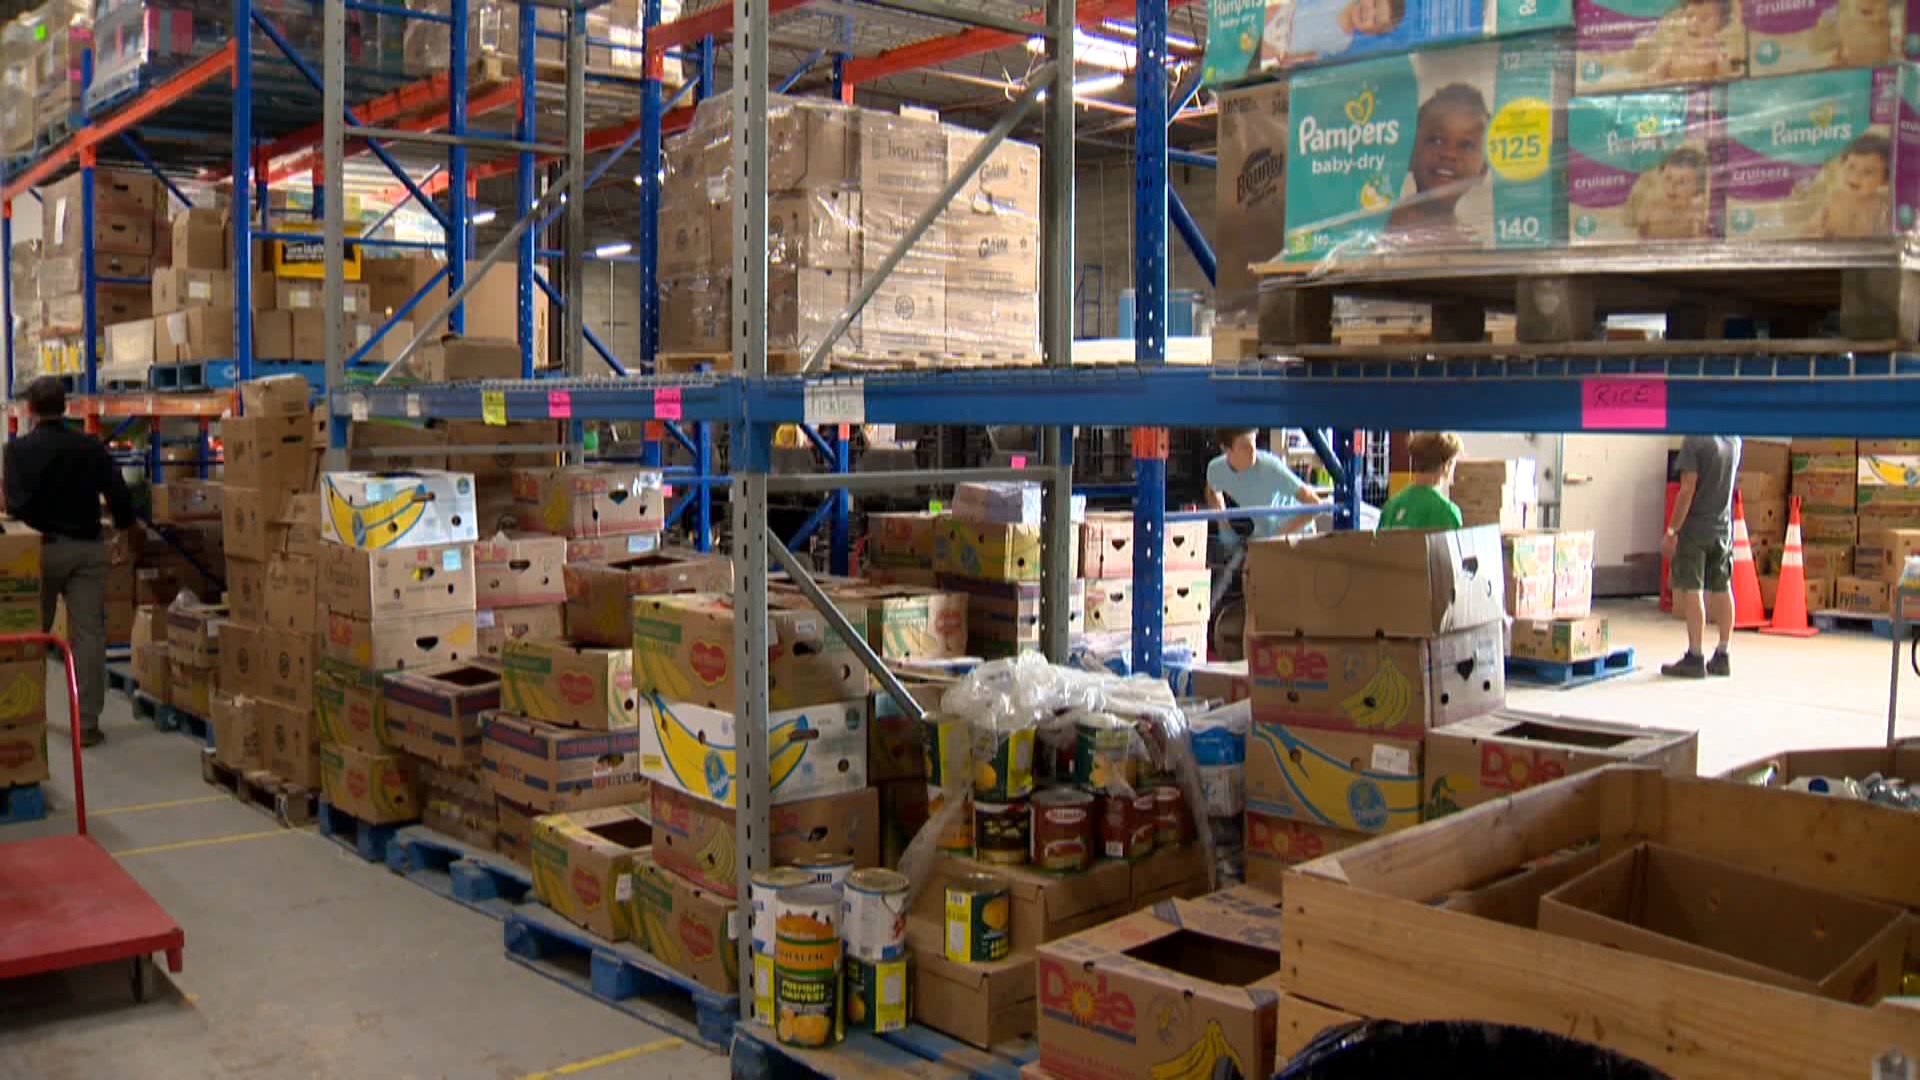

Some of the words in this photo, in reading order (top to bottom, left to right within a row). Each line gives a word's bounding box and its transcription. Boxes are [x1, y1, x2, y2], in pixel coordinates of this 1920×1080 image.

[1299, 115, 1400, 156] Pampers
[1772, 119, 1852, 146] Pampers
[1490, 134, 1541, 161] $125
[1311, 152, 1386, 175] baby-dry
[1732, 167, 1791, 181] cruisers
[1574, 174, 1626, 189] cruisers
[1498, 215, 1540, 241] 140
[1592, 383, 1649, 409] RICE
[1039, 953, 1137, 1033] Dole
